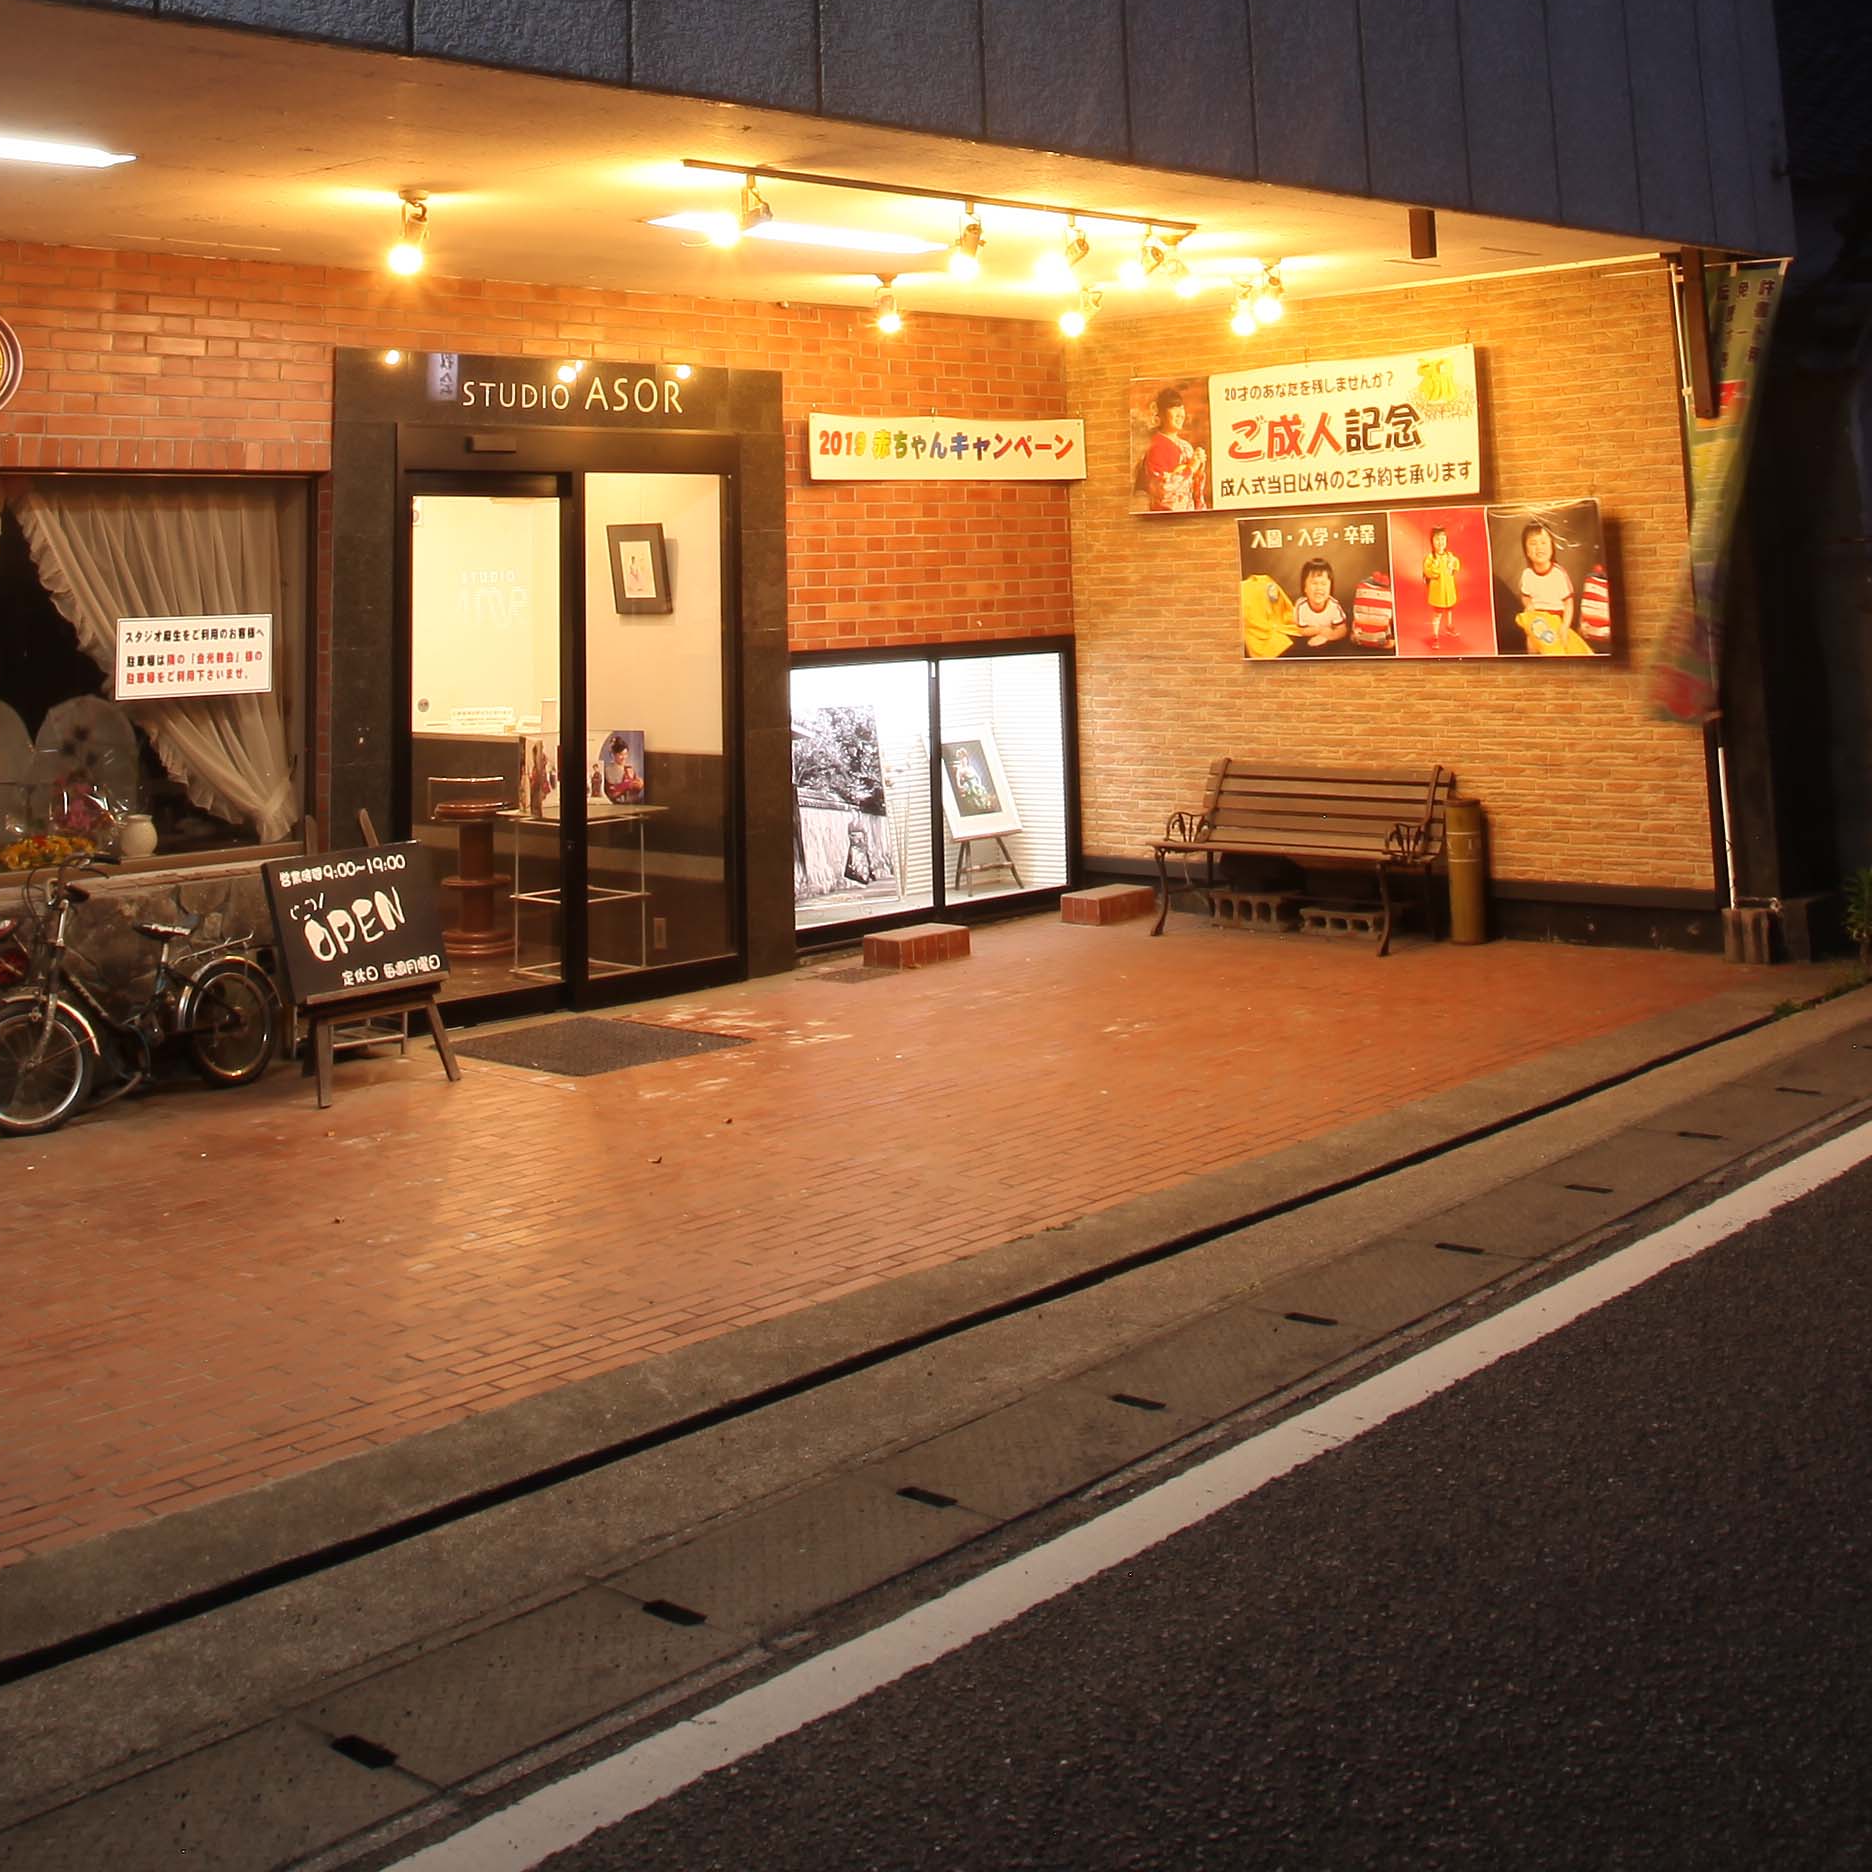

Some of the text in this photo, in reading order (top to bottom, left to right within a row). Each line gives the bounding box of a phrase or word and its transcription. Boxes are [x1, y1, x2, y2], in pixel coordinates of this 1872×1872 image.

[462, 377, 684, 414] STUDIO ASOR
[872, 429, 1074, 461] 赤ちゃんキャンペーン
[1227, 402, 1425, 461] ご成人記念
[1220, 460, 1473, 498] 成人式当日以外のご予約も承ります
[304, 886, 406, 962] OPEN
